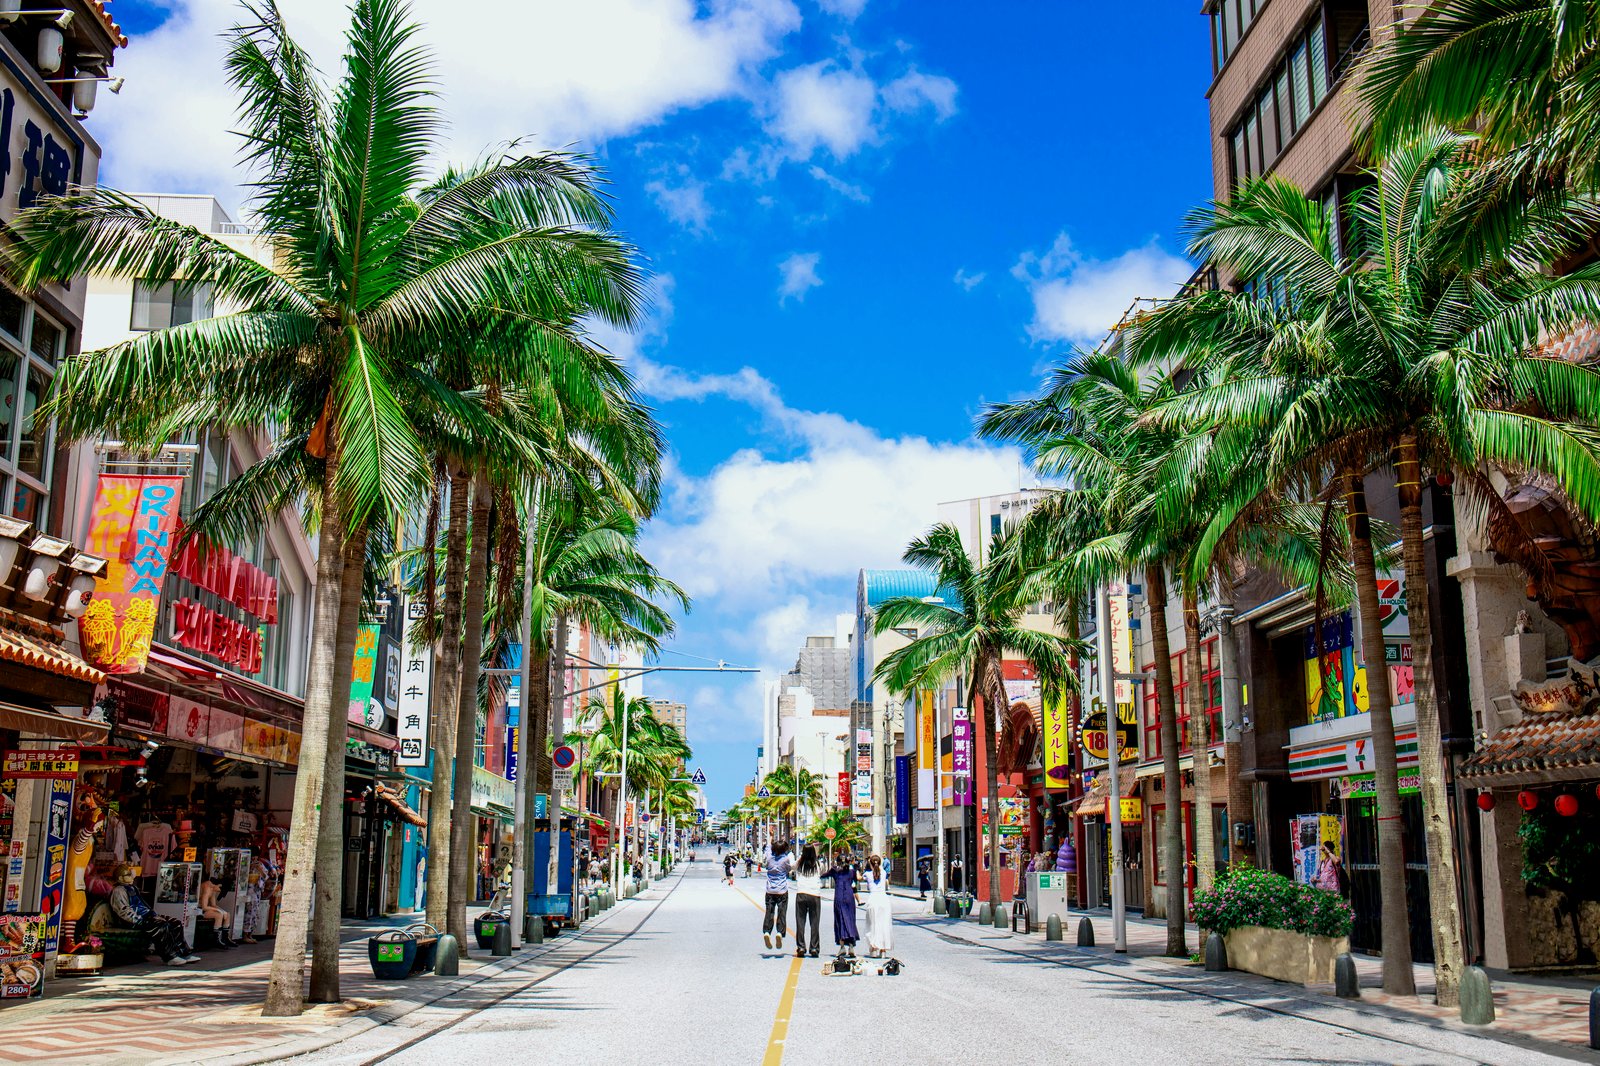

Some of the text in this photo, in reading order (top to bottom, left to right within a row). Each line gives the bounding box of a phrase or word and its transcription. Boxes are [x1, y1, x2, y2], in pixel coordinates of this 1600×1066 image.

[129, 485, 175, 595] OKINAWA
[1386, 646, 1397, 659] 酒
[1403, 647, 1412, 659] AT
[954, 725, 966, 793] 御菓子
[53, 780, 72, 794] SPAM
[47, 925, 58, 939] AM
[8, 986, 28, 994] 280円
